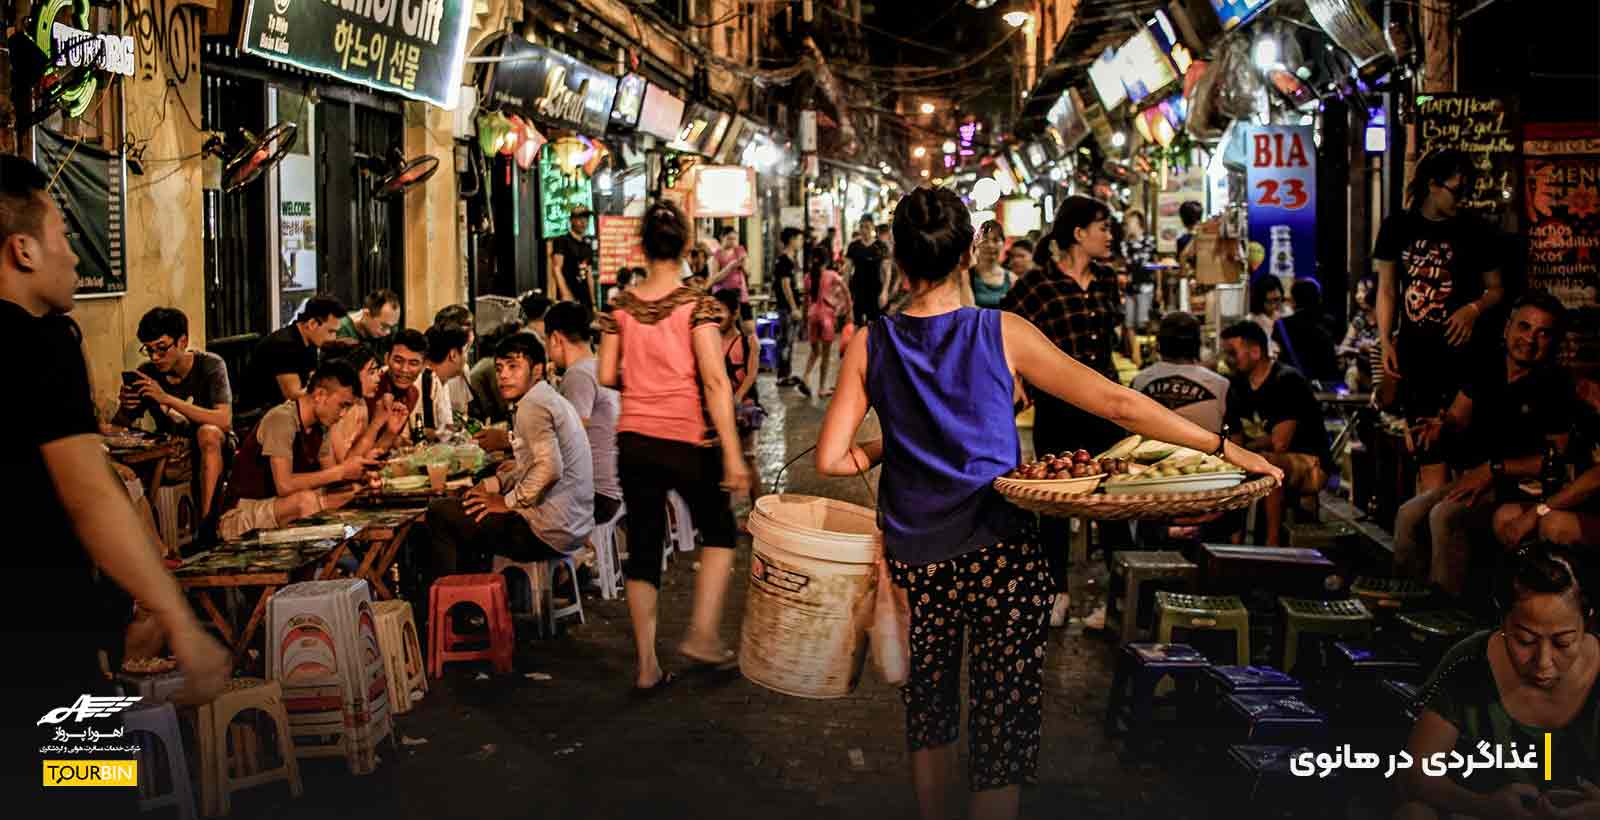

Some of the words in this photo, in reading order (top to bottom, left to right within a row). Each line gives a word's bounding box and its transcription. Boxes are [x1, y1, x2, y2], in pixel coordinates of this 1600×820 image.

[334, 19, 388, 81] 하노이
[389, 39, 421, 90] 선물
[1422, 119, 1460, 141] Buy
[1460, 117, 1474, 135] 2
[1253, 134, 1309, 168] BIA
[1550, 167, 1600, 184] MEN
[1256, 179, 1308, 210] 23
[281, 201, 312, 217] WELCOME
